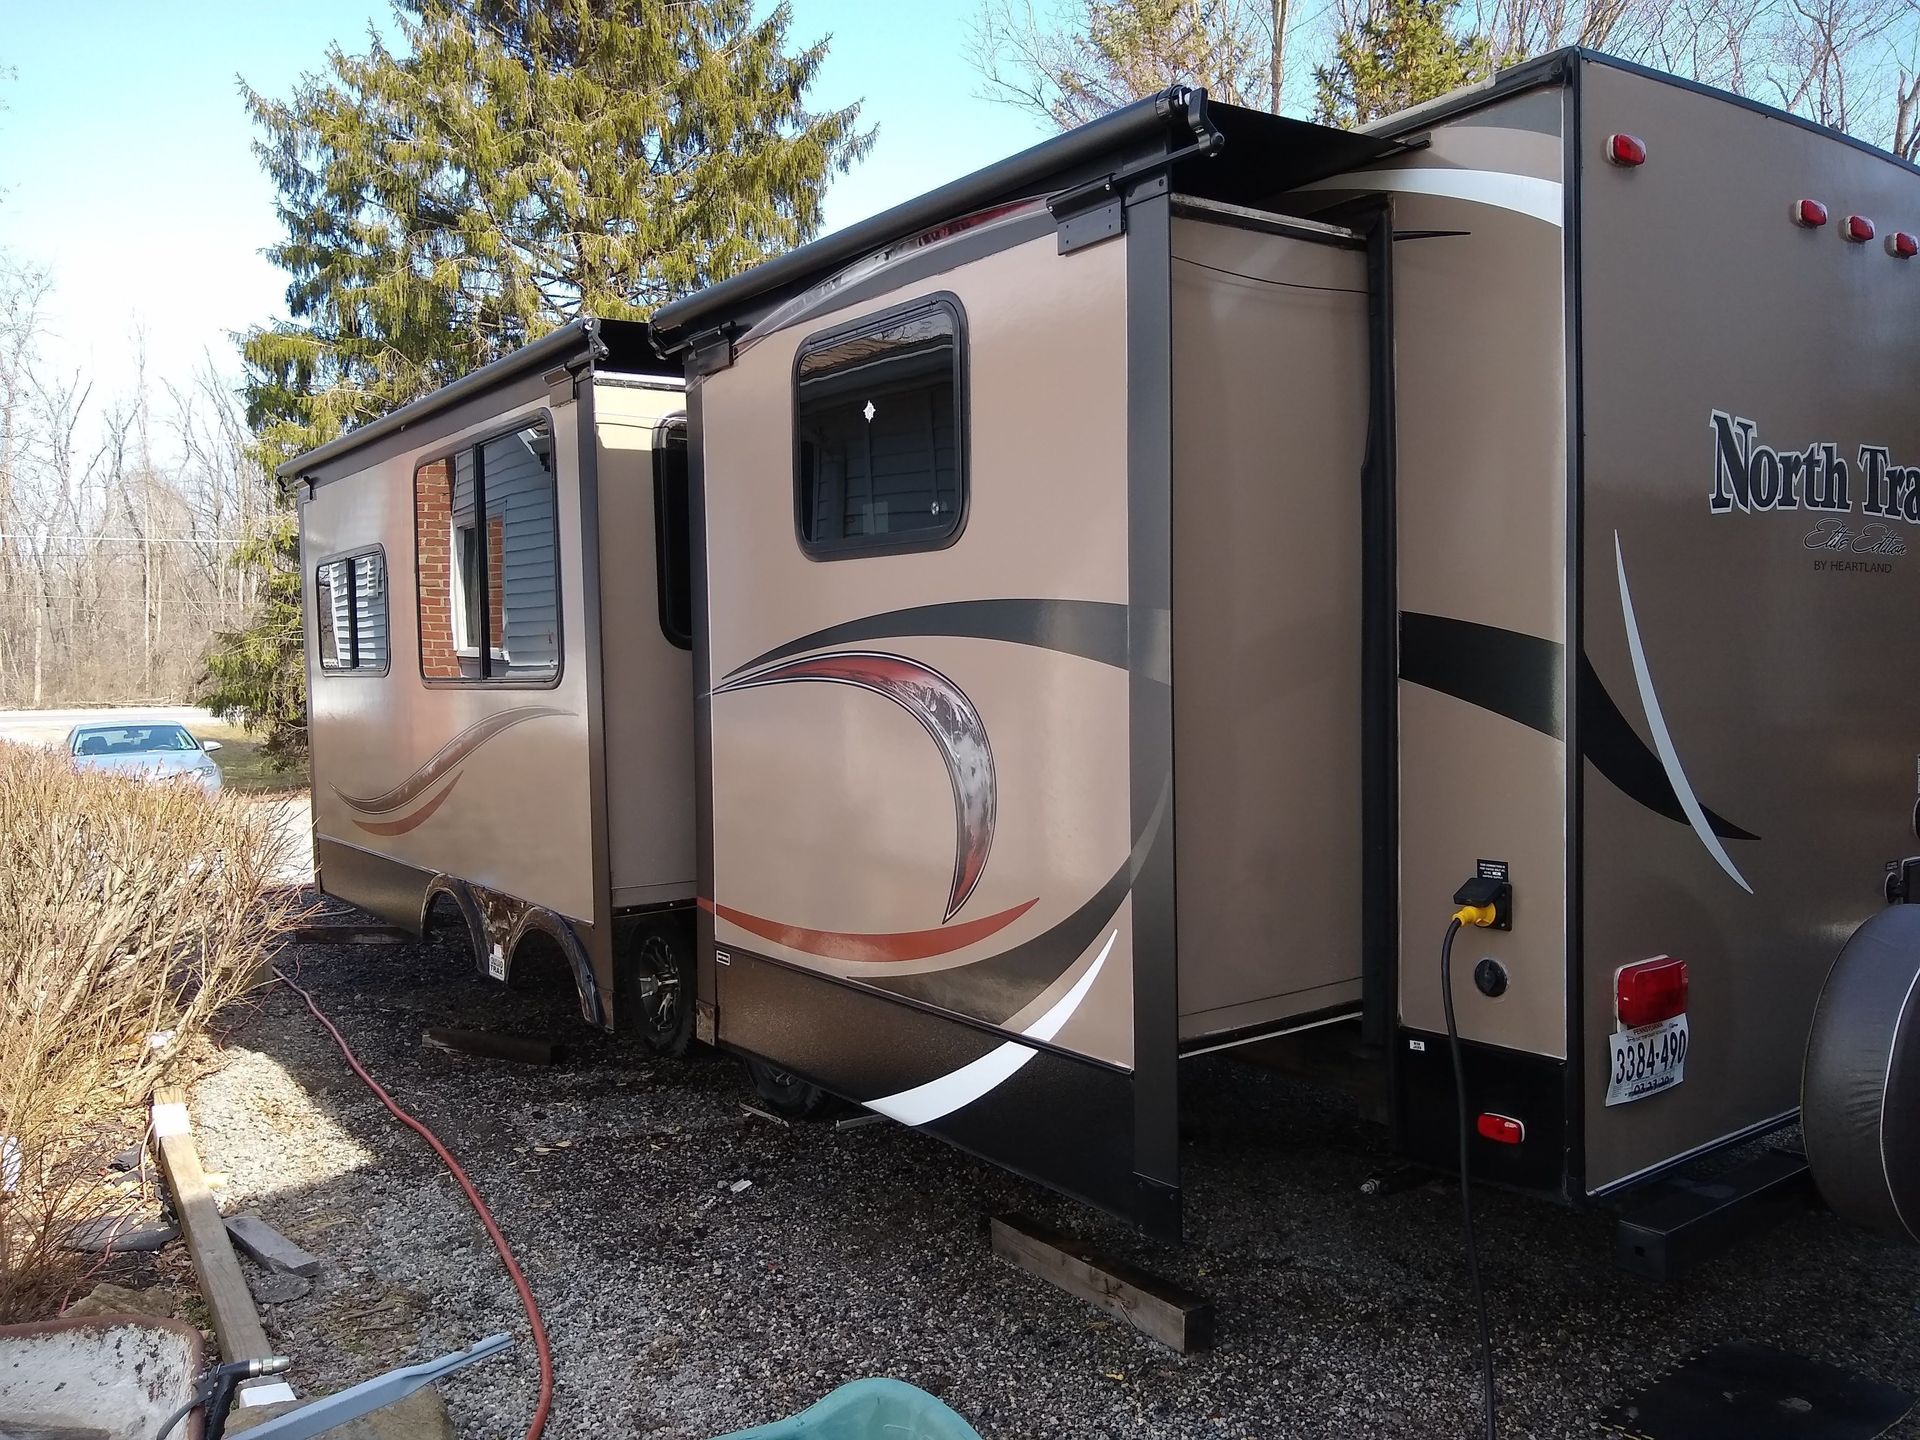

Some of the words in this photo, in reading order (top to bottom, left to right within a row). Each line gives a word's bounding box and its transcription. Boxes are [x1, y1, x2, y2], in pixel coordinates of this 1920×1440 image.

[1709, 408, 1852, 514] North
[1803, 518, 1854, 551] Elite
[1852, 523, 1908, 556] Edition
[1814, 560, 1827, 571] BY
[1830, 561, 1893, 574] HEARTLAND
